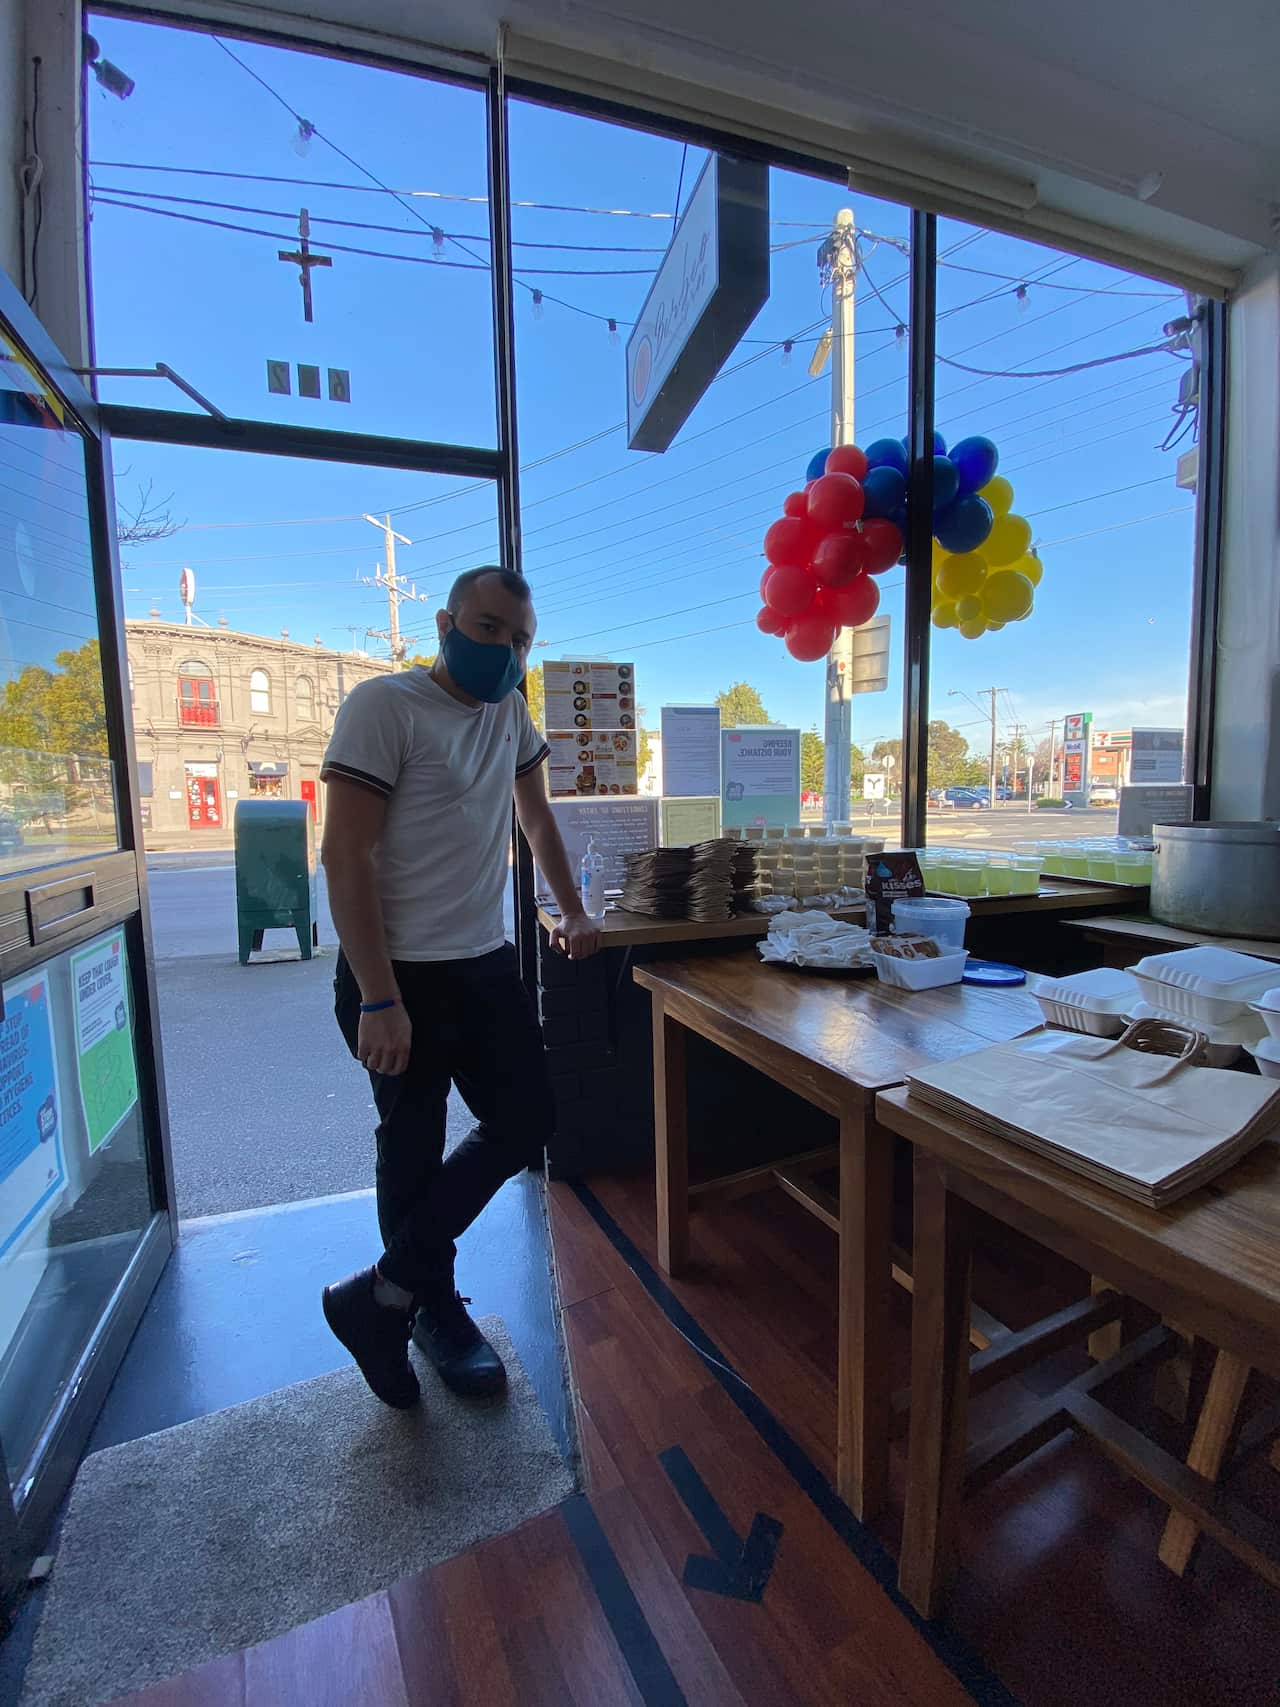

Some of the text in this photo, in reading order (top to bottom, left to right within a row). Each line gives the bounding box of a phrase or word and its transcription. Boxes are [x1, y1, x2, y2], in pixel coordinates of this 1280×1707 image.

[1097, 733, 1109, 746] 7
[79, 970, 91, 988] KEEP
[92, 962, 104, 980] THAT
[80, 981, 96, 1002] UNDER
